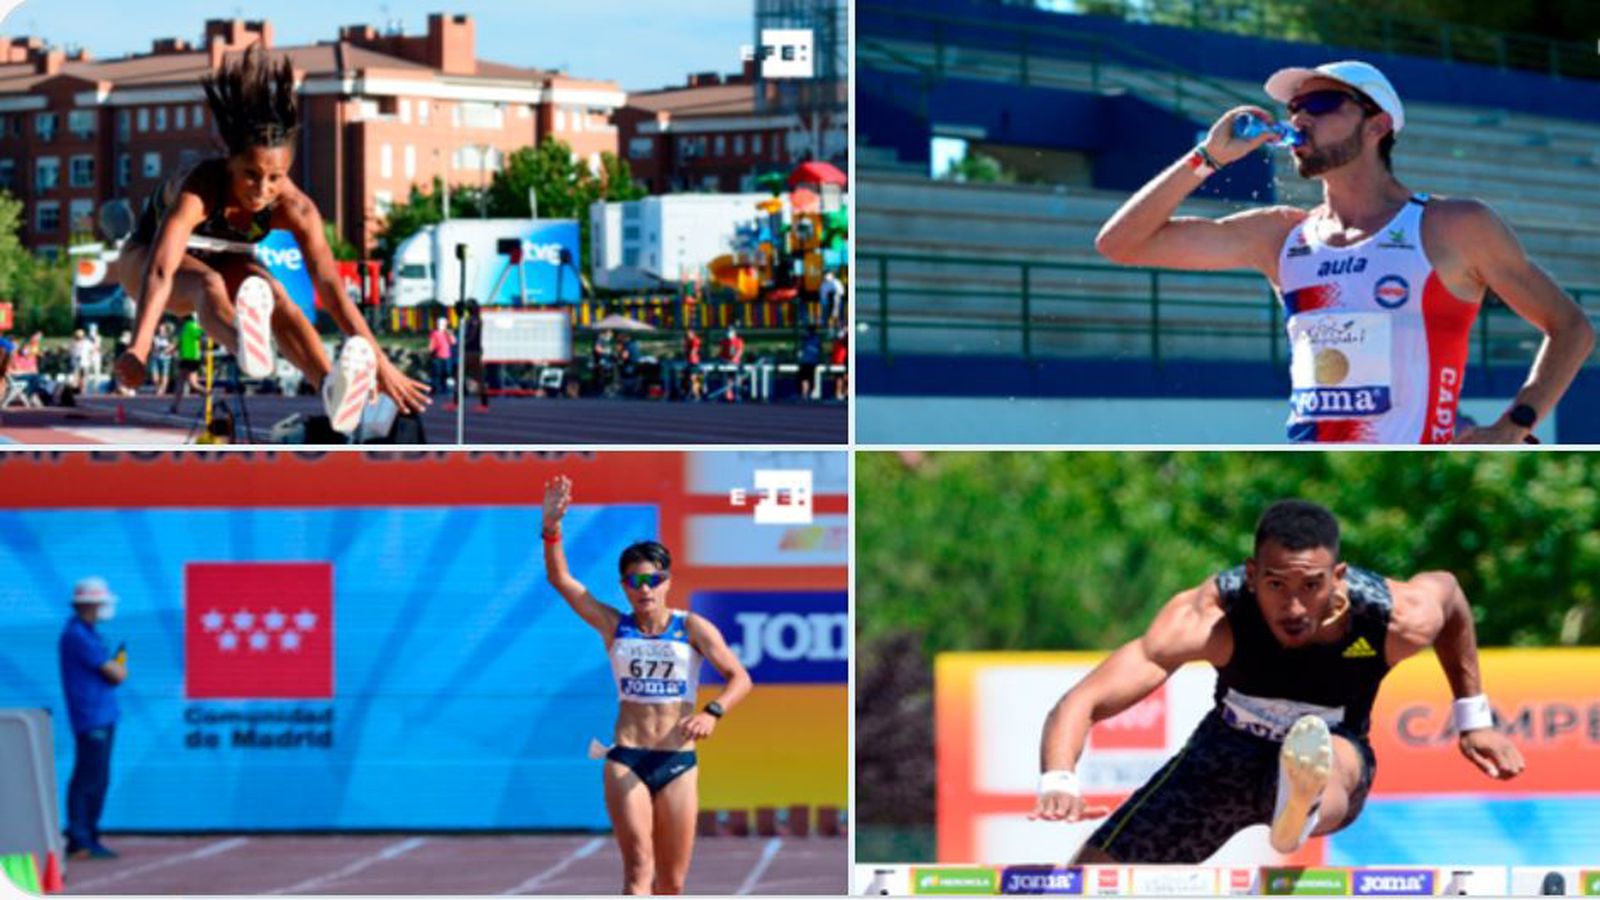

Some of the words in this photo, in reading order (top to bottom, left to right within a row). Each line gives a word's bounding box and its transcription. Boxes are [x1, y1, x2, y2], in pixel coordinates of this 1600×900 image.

[1317, 256, 1368, 277] aula
[629, 659, 675, 679] 677
[184, 708, 334, 725] Comunidad
[186, 731, 220, 748] de
[231, 730, 333, 748] Madrid
